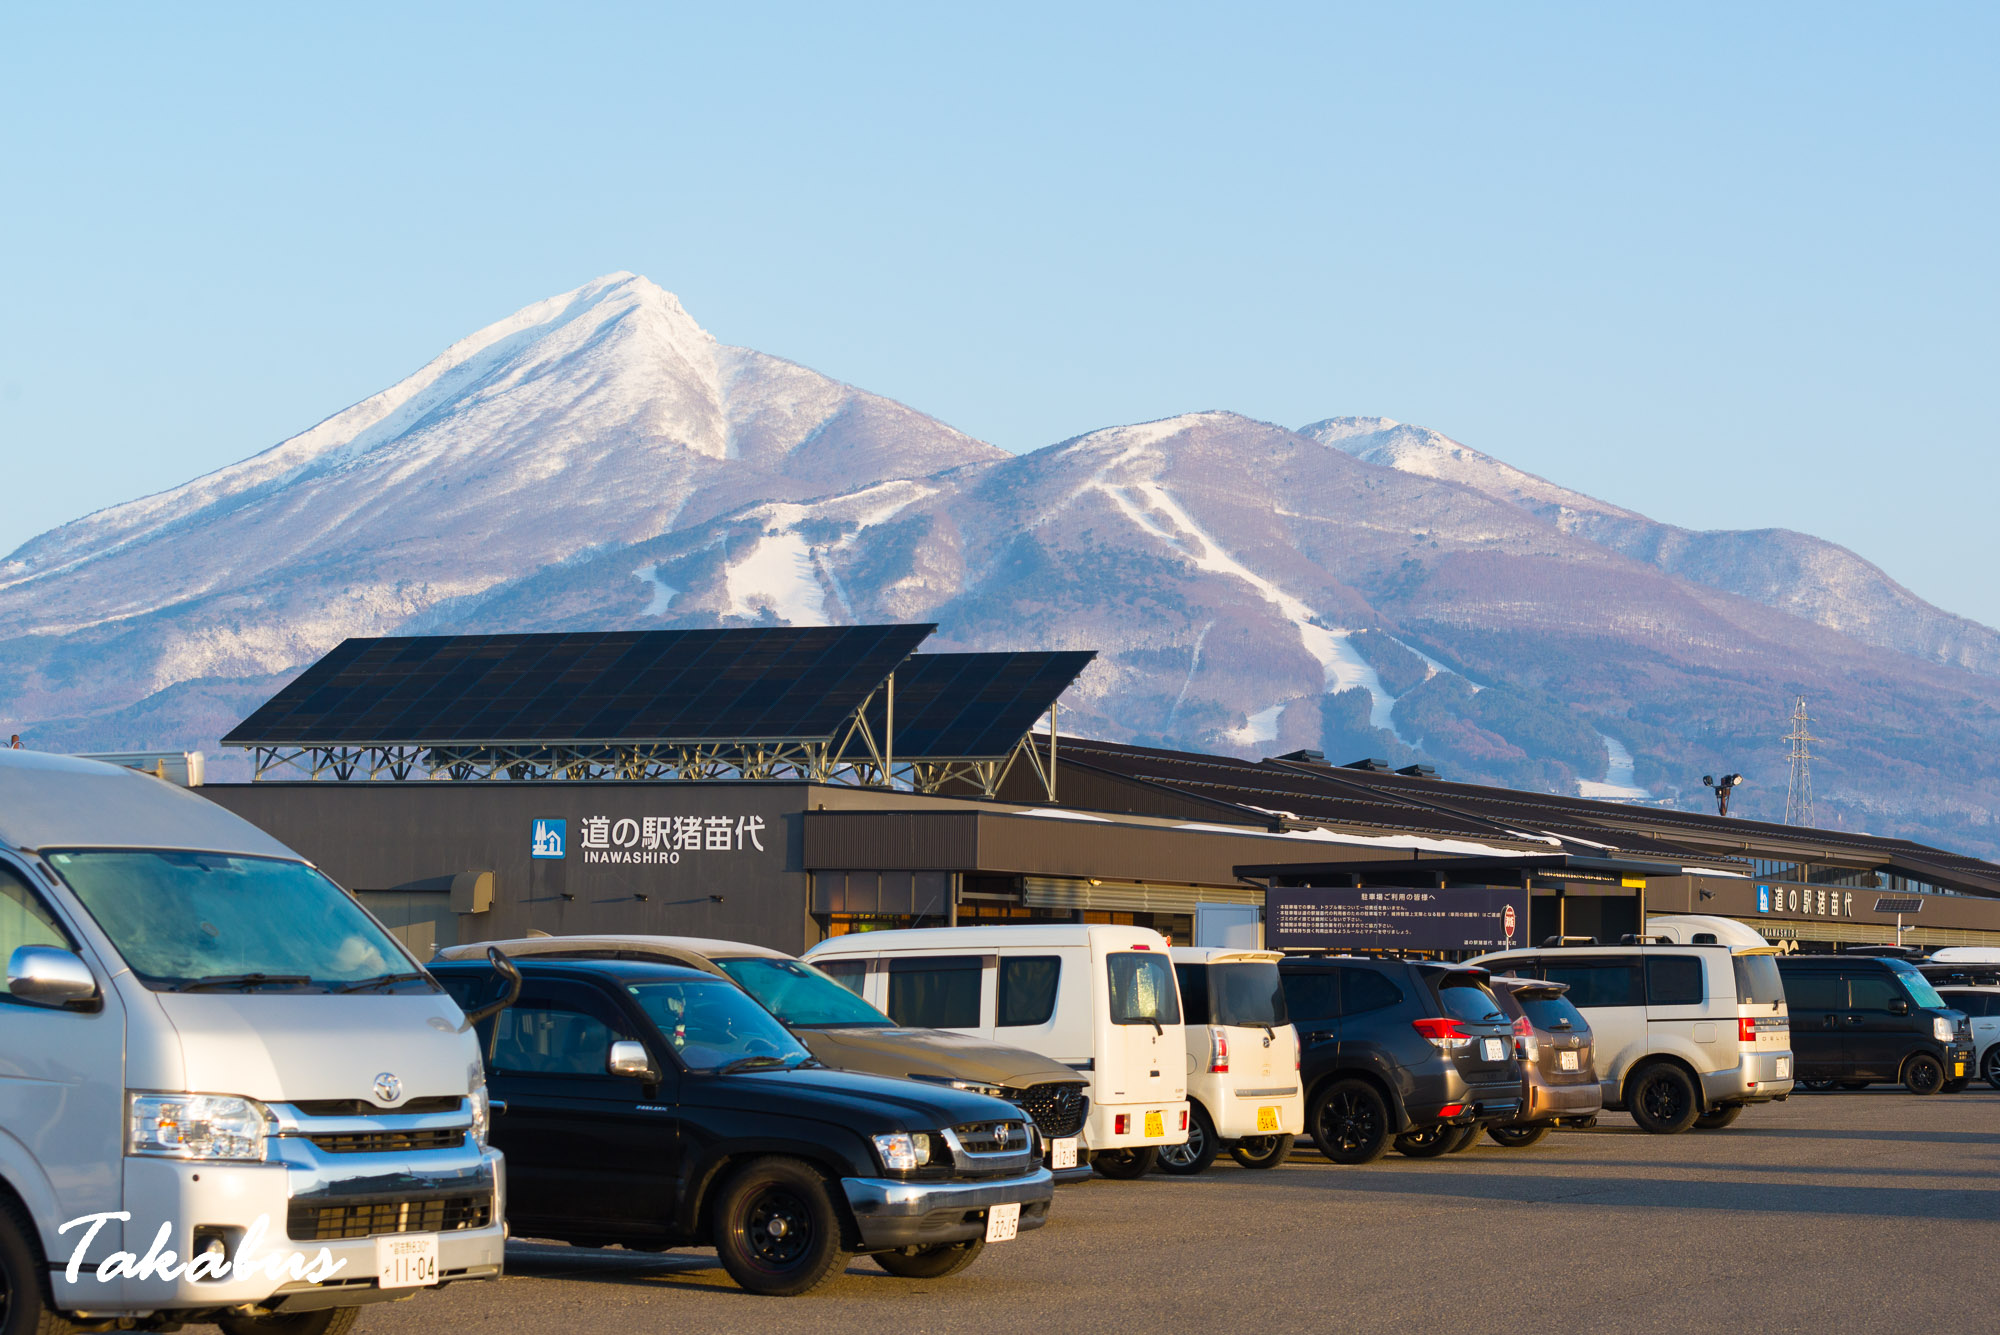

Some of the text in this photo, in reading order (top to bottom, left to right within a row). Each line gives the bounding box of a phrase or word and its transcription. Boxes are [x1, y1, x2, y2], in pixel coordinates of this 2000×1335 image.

[581, 815, 765, 852] 道の駅猪苗代
[584, 851, 680, 864] INAWASHIRO
[1361, 893, 1436, 902] 駐車場ご利用の皆様へ
[1774, 886, 1853, 917] 道の駅猪苗代
